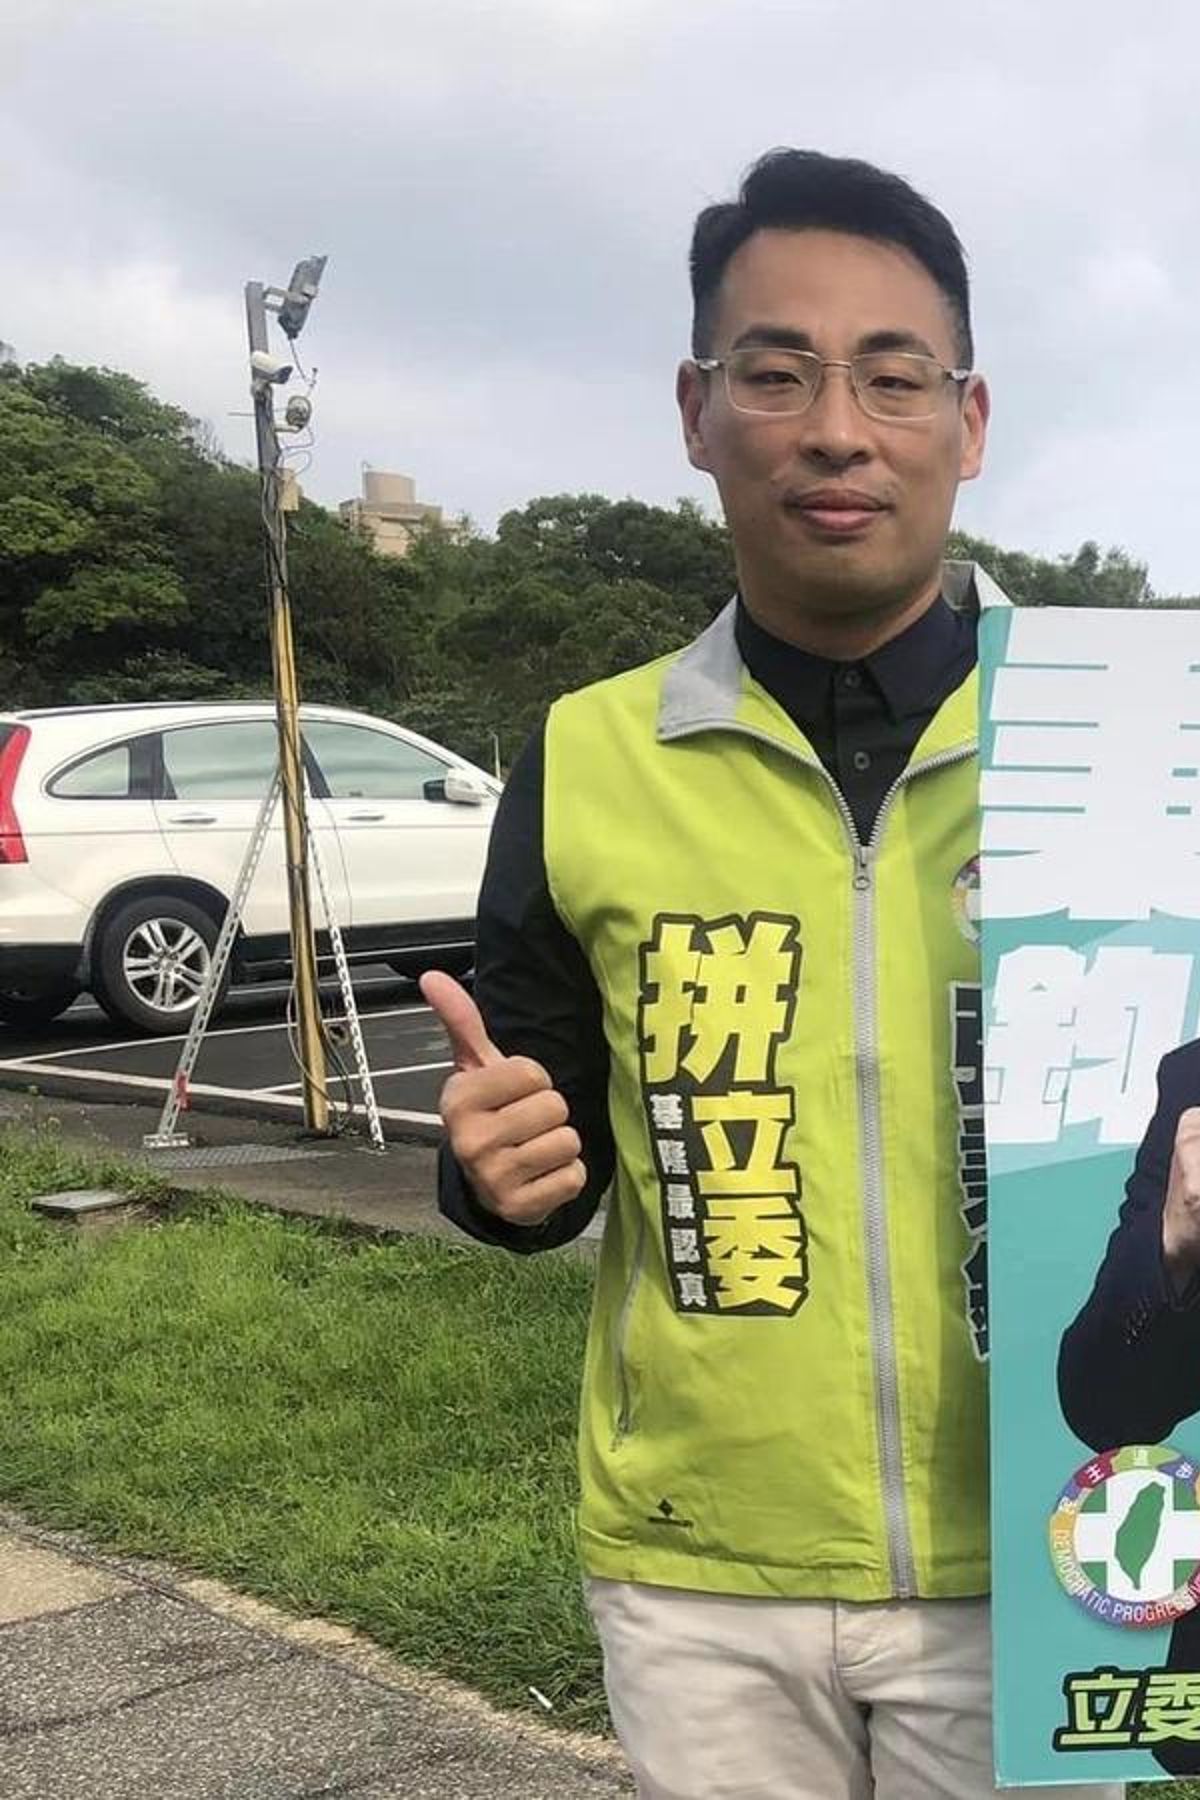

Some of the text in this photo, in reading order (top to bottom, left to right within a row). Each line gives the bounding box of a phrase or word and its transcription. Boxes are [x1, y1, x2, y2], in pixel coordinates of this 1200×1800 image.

[642, 920, 804, 1311] 拼立委
[1053, 1528, 1112, 1615] DEMOCRATIC
